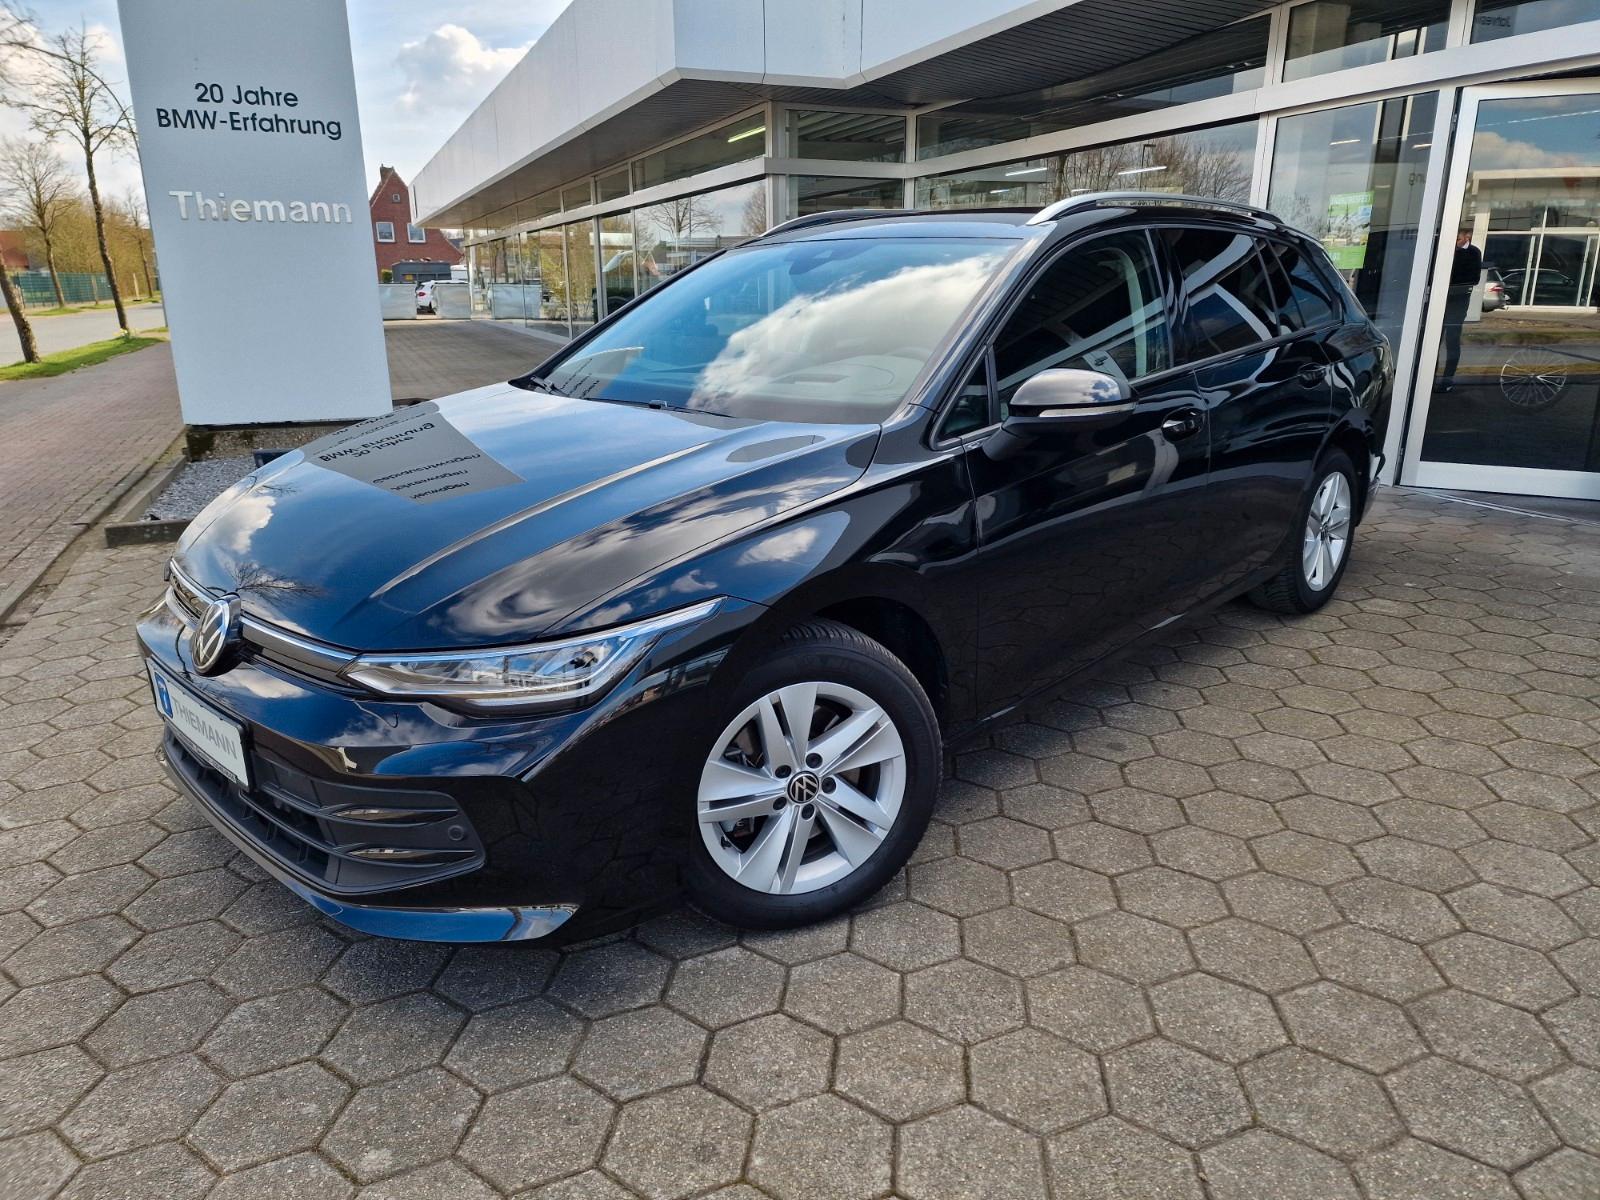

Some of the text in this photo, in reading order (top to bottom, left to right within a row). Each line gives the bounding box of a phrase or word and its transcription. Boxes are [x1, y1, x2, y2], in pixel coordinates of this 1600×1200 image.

[194, 82, 299, 107] 20 Jahre
[156, 108, 342, 140] BMW-Erfahrung
[168, 190, 353, 224] Thiemann
[172, 697, 238, 760] THIEMANN
